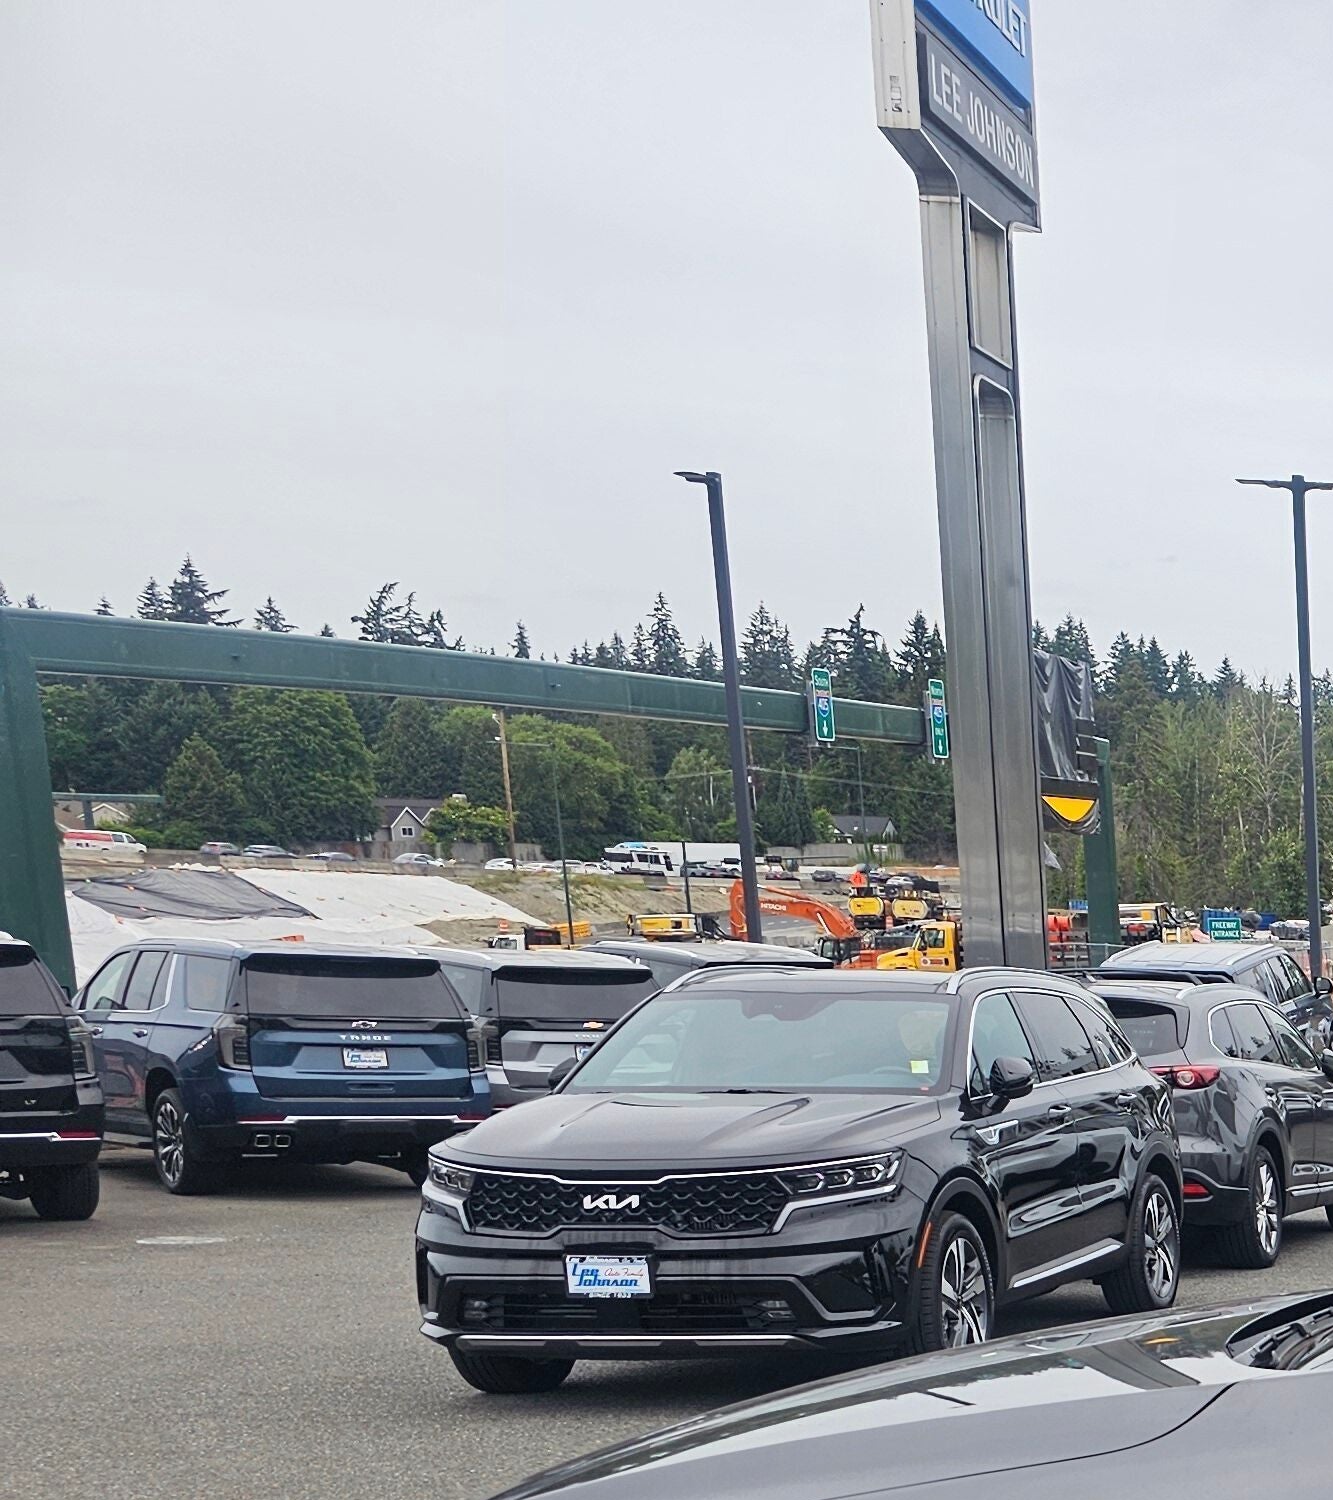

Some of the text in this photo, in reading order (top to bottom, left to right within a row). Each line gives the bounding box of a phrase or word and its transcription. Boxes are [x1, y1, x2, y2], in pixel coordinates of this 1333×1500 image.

[931, 53, 963, 124] LEE
[967, 91, 1034, 189] JOHNSON
[760, 902, 787, 911] HITACHI
[1211, 921, 1238, 929] FREEWAY
[1210, 930, 1240, 938] ENTRANCE
[582, 1194, 640, 1210] KIA
[572, 1263, 600, 1276] Lee
[575, 1269, 639, 1287] Johnson
